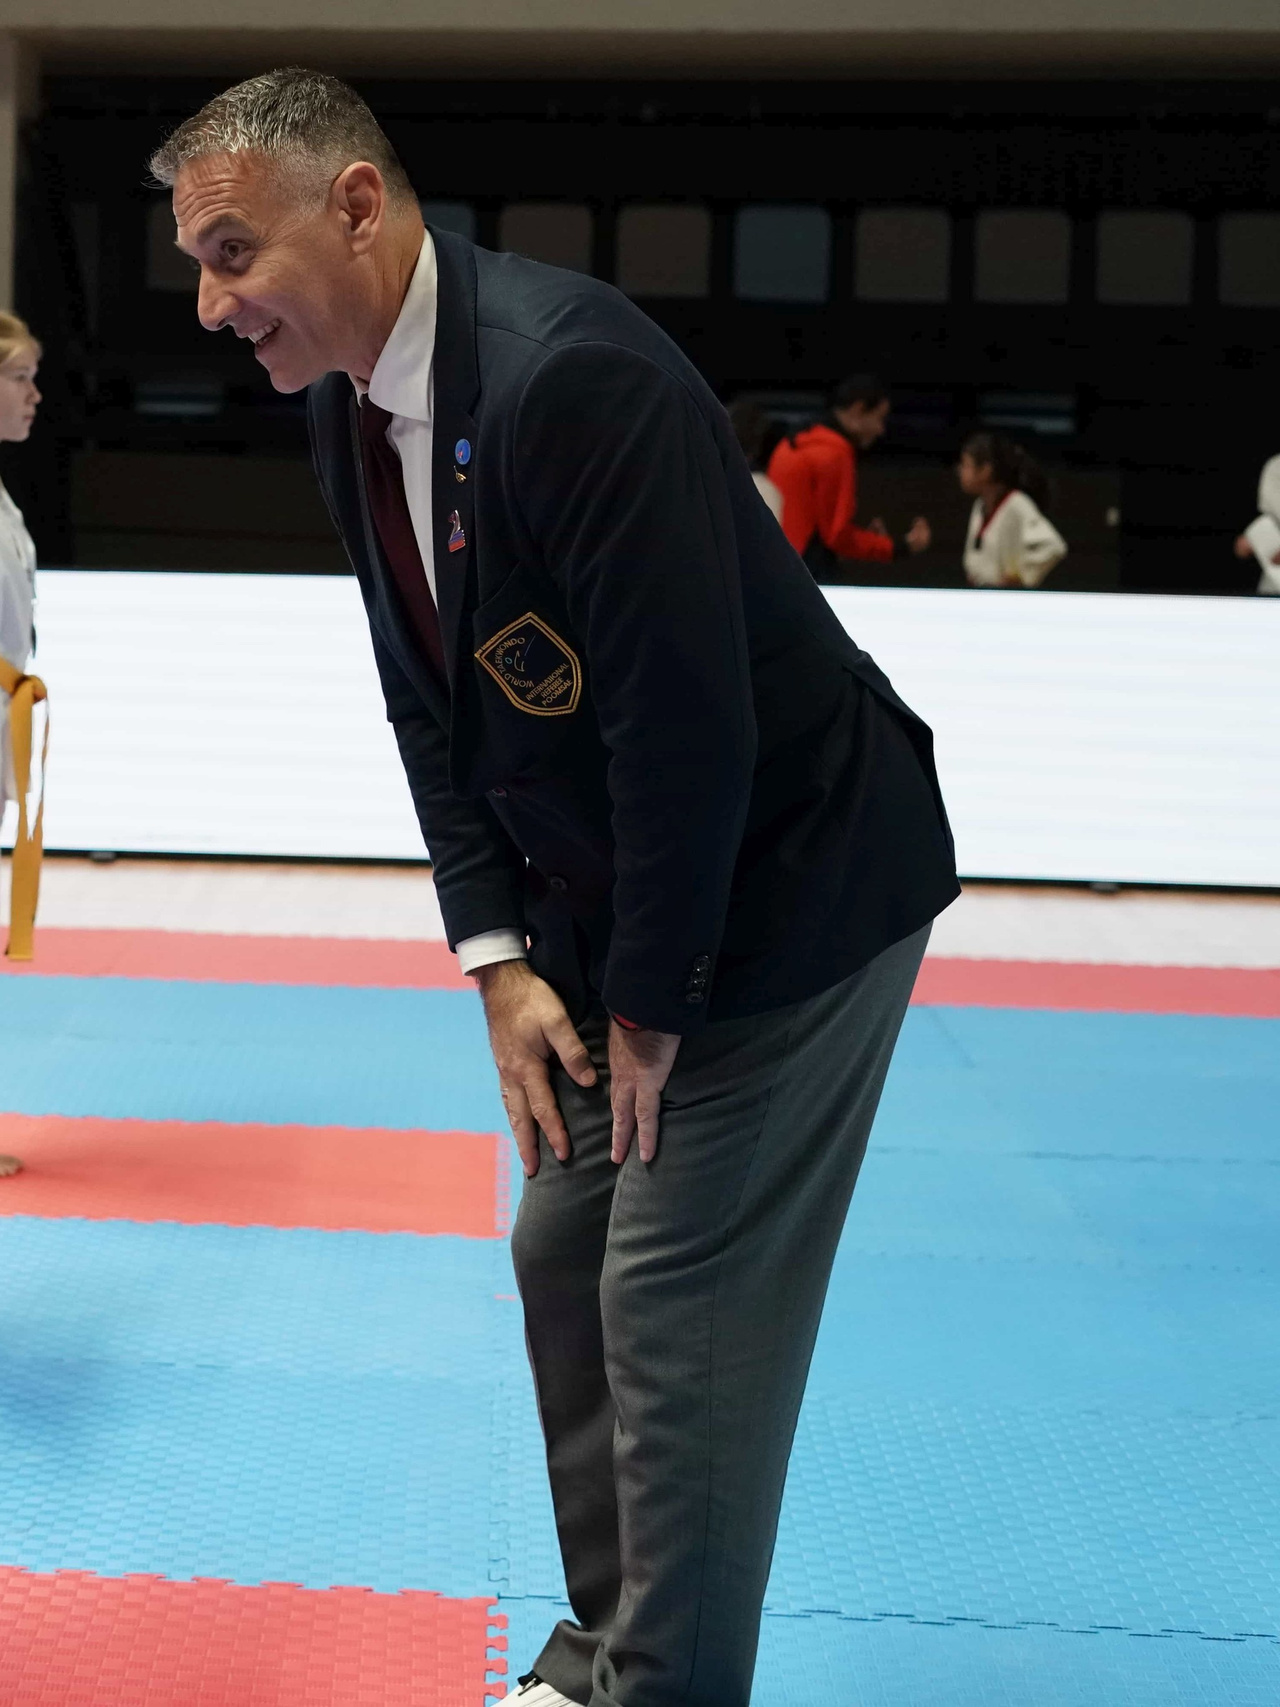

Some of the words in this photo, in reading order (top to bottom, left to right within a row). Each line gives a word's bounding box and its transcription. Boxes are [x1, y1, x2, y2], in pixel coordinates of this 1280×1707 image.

[495, 637, 525, 674] TAEKWONDO
[504, 673, 534, 688] WORLD
[525, 662, 569, 701] INTERNATIONAL
[540, 677, 564, 699] REFEREE
[541, 679, 573, 706] POOMSAE
